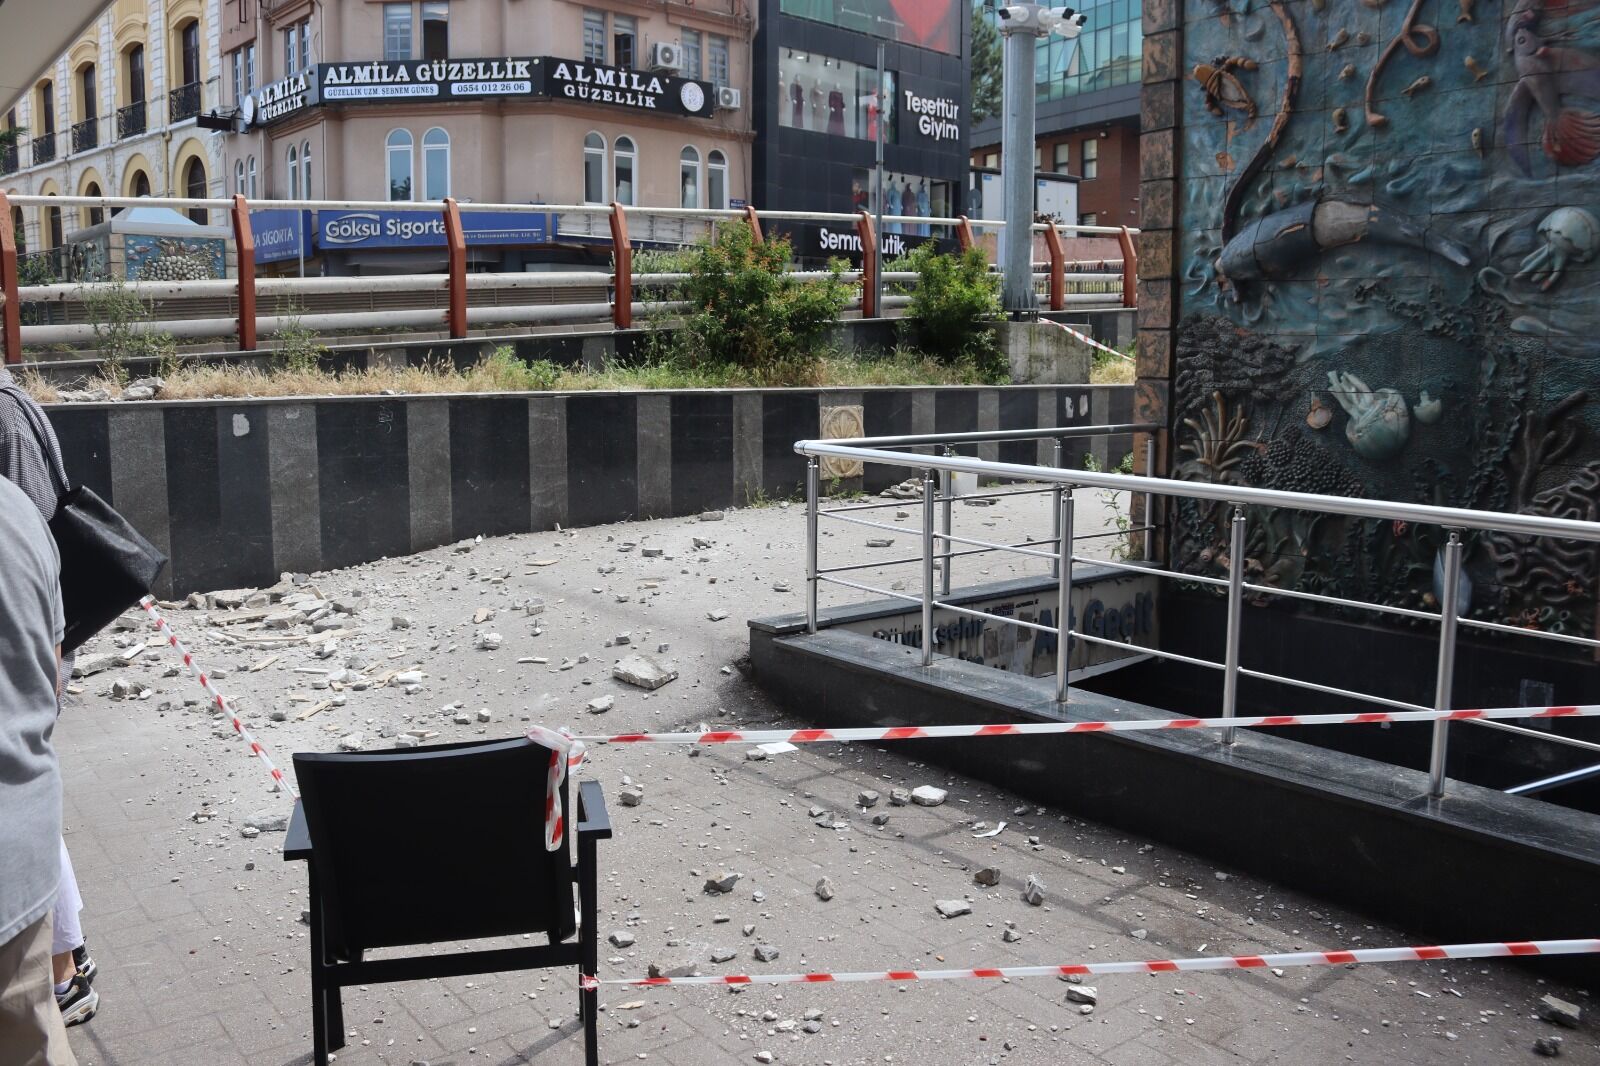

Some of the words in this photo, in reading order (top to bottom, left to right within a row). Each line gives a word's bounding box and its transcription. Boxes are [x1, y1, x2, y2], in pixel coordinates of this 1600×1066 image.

[323, 60, 410, 85] ALMİLA
[415, 56, 531, 82] GÜZELLİK
[552, 62, 664, 95] ALMİLA
[257, 73, 307, 108] ALMİLA
[481, 83, 498, 92] 012
[500, 83, 512, 91] 26
[513, 82, 525, 91] 06
[563, 83, 656, 109] GÜZELLİK
[262, 94, 303, 121] GÜZELLİK
[905, 89, 959, 120] Tesettür
[918, 114, 959, 141] Giyim
[325, 219, 381, 237] Göksu
[875, 232, 906, 256] utik
